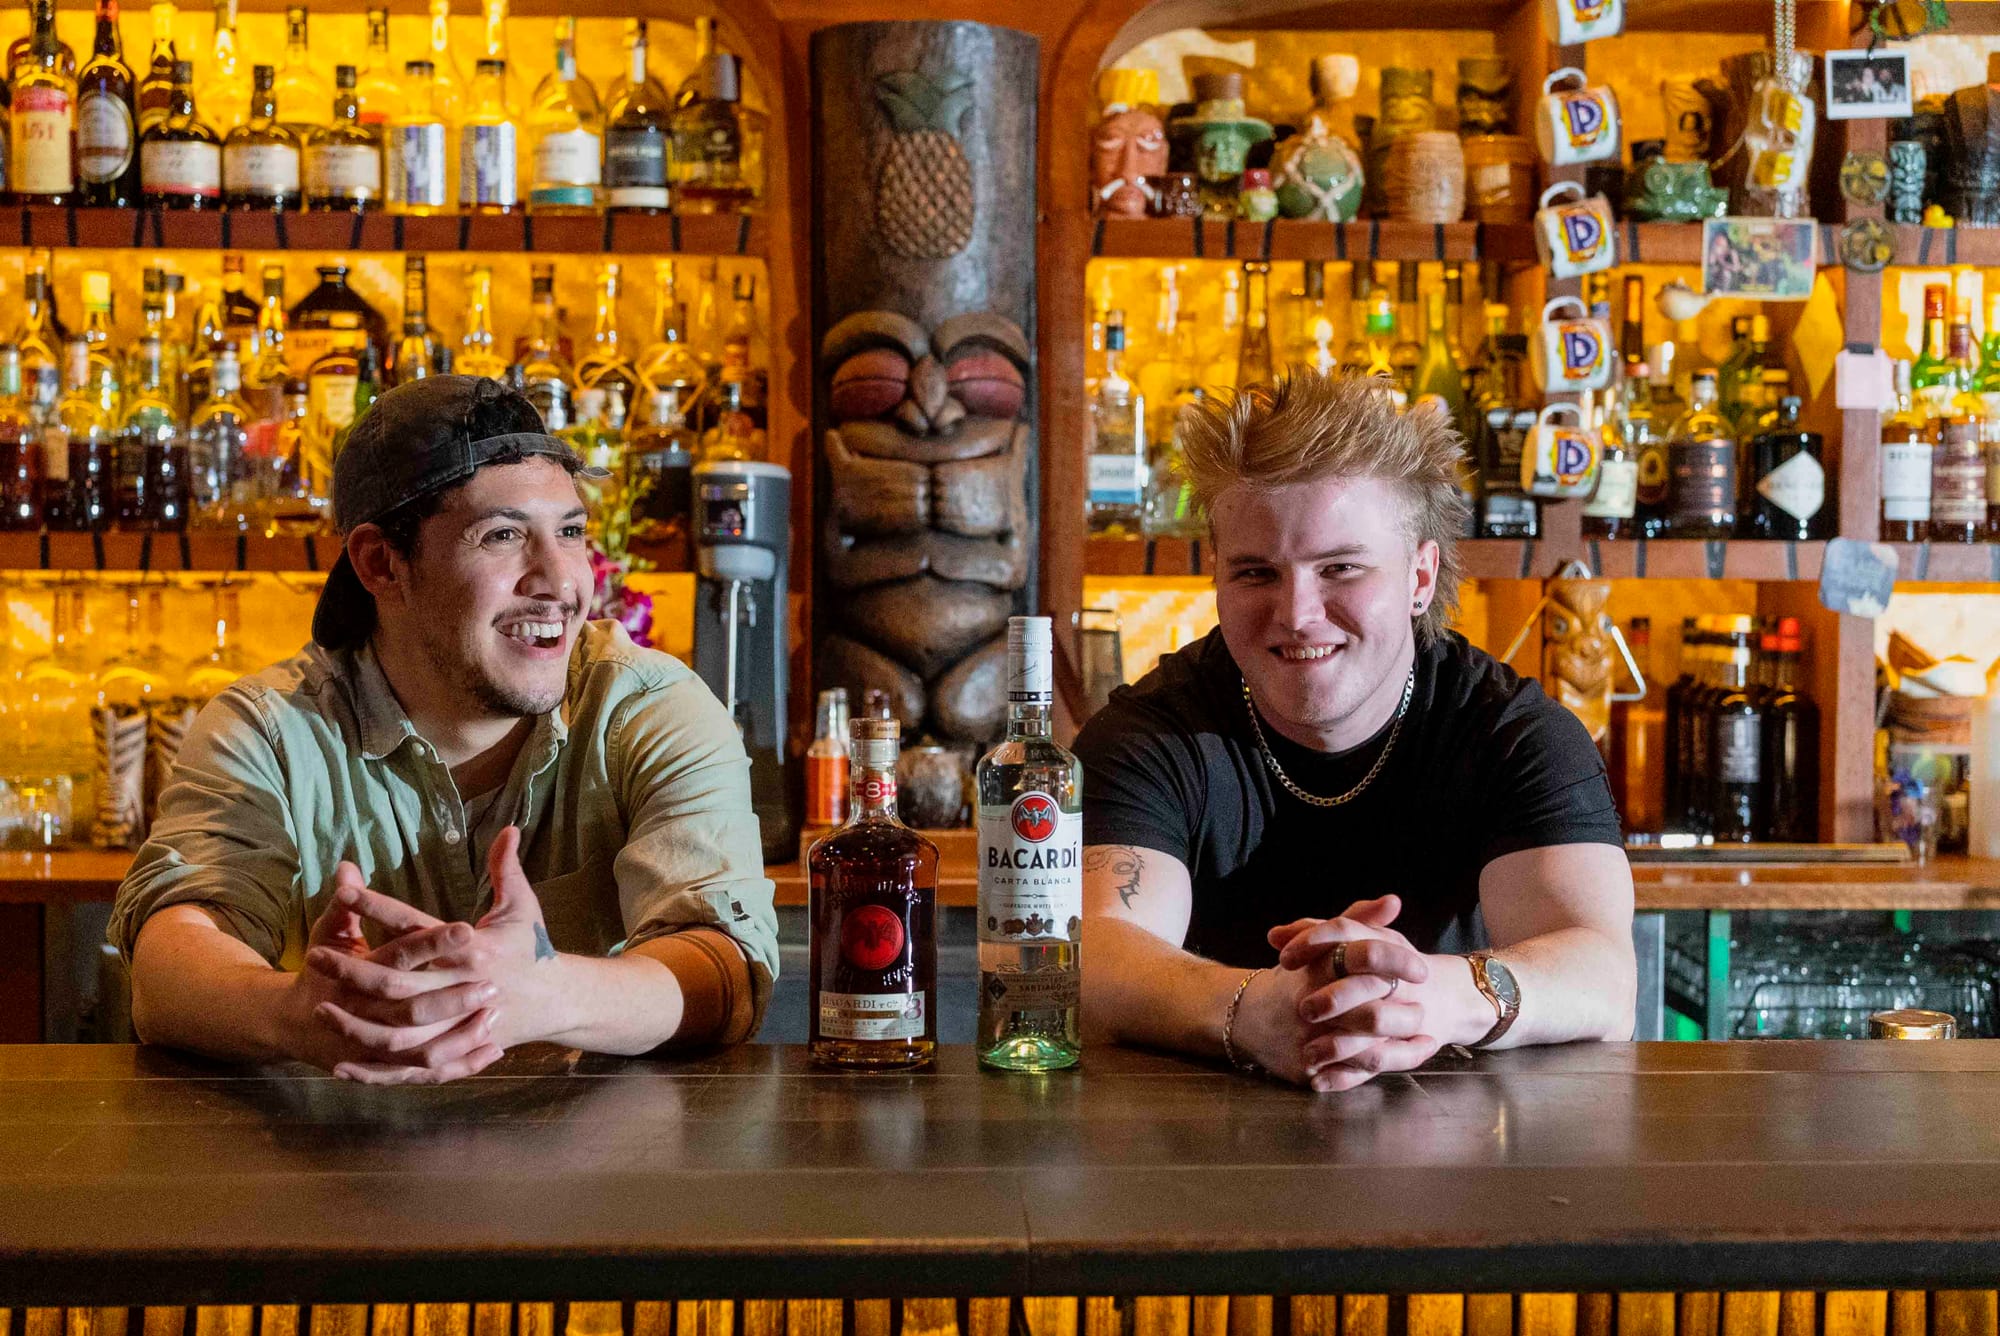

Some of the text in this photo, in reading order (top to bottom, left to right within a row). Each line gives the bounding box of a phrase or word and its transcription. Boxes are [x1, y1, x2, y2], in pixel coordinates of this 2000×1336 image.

[866, 781, 881, 798] 8
[988, 841, 1077, 870] BACARDÍ
[994, 876, 1071, 886] CARTA BLANCA
